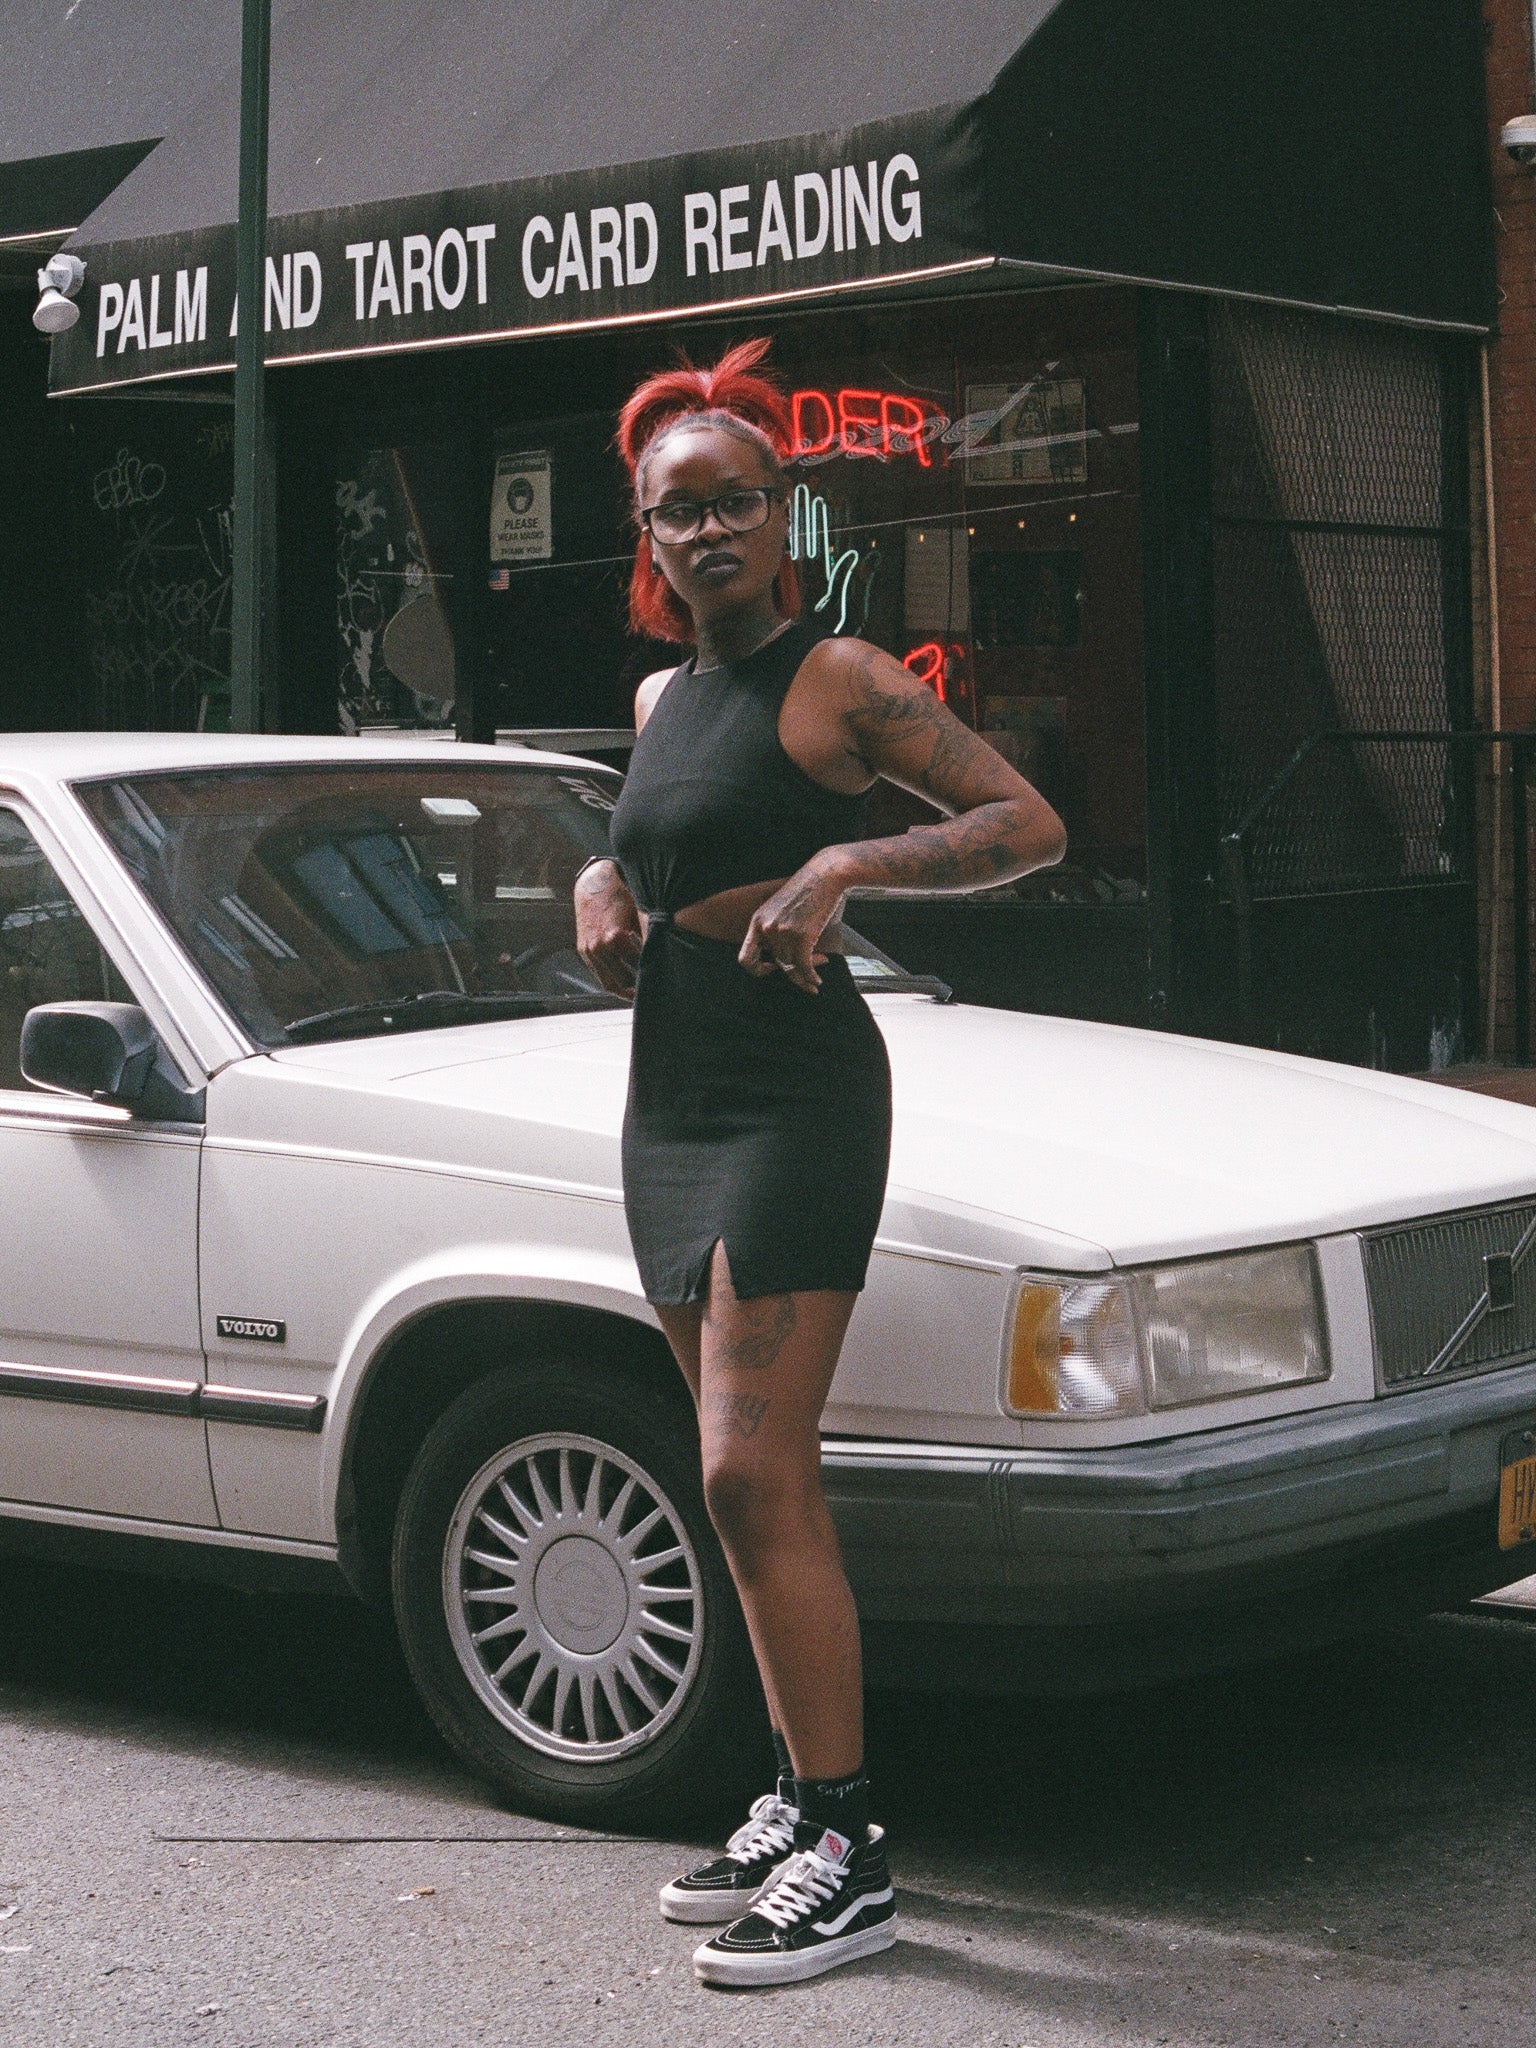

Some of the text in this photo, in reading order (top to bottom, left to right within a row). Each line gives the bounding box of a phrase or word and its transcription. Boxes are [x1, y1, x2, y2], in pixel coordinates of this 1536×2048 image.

[97, 153, 923, 358] PALM ND TAROT CARD READING
[504, 518, 539, 530] PLEASE
[220, 1319, 278, 1337] VOLVO
